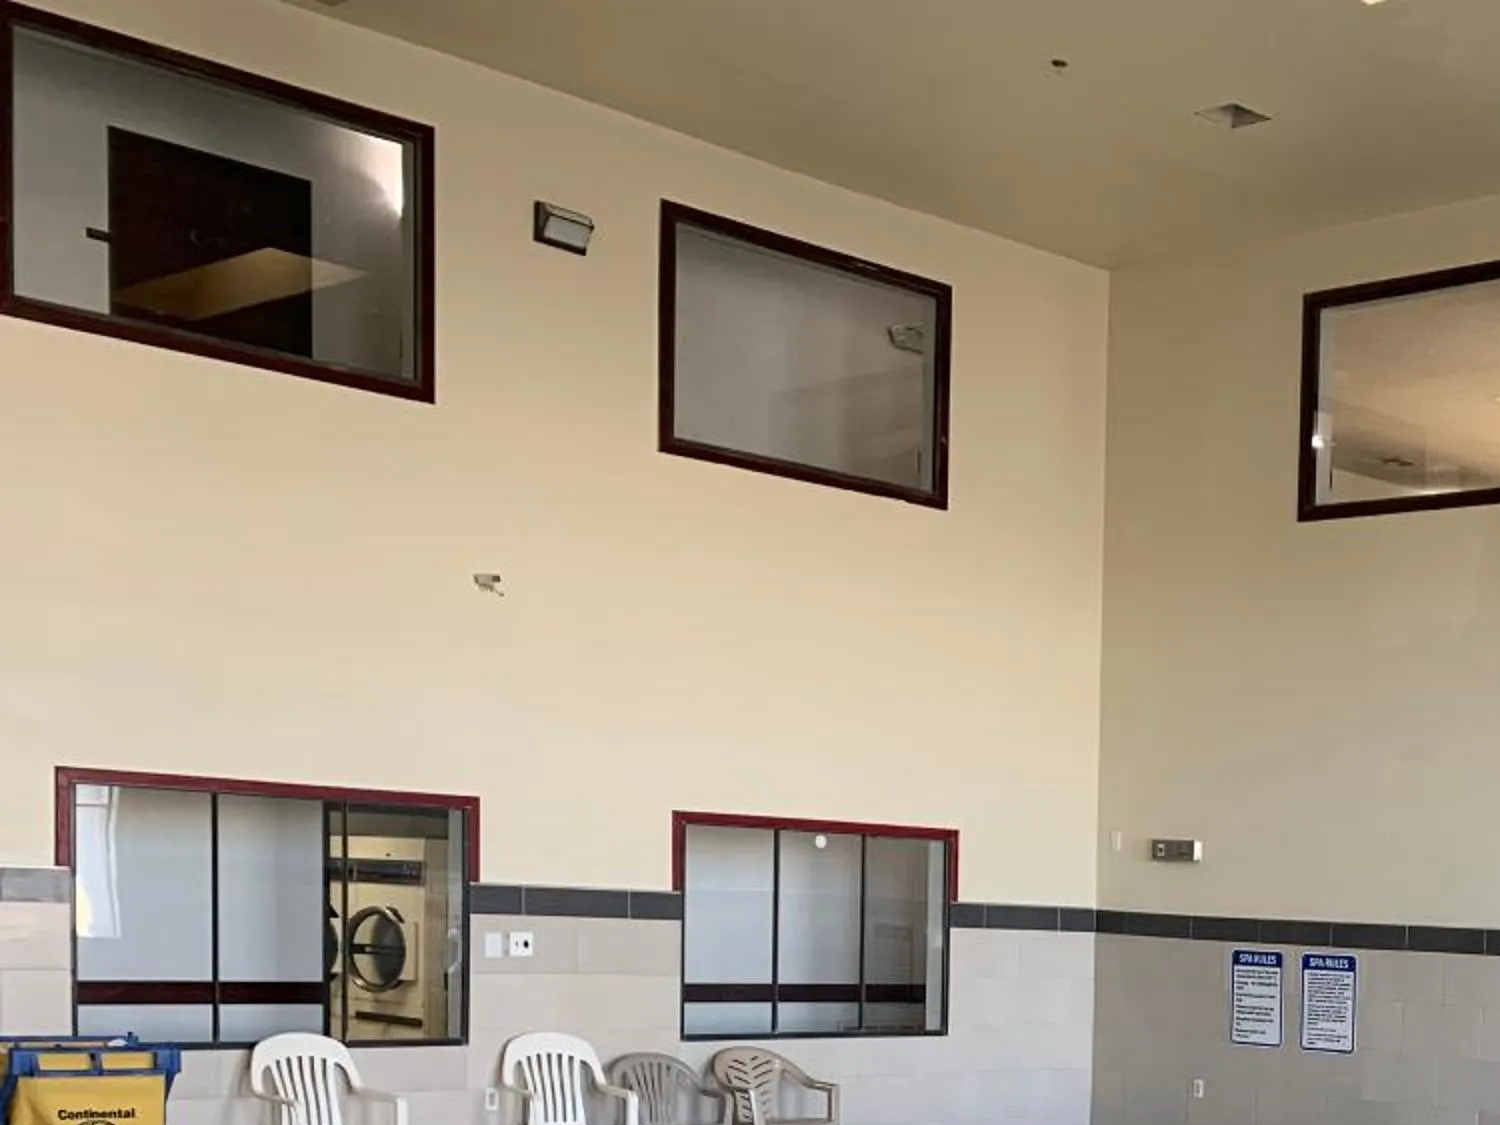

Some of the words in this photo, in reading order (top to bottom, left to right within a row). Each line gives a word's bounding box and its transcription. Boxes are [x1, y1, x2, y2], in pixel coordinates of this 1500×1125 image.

[1239, 953, 1252, 963] SPA
[1309, 956, 1325, 967] SPA
[1325, 957, 1349, 969] RULES
[57, 1107, 136, 1120] Continental
